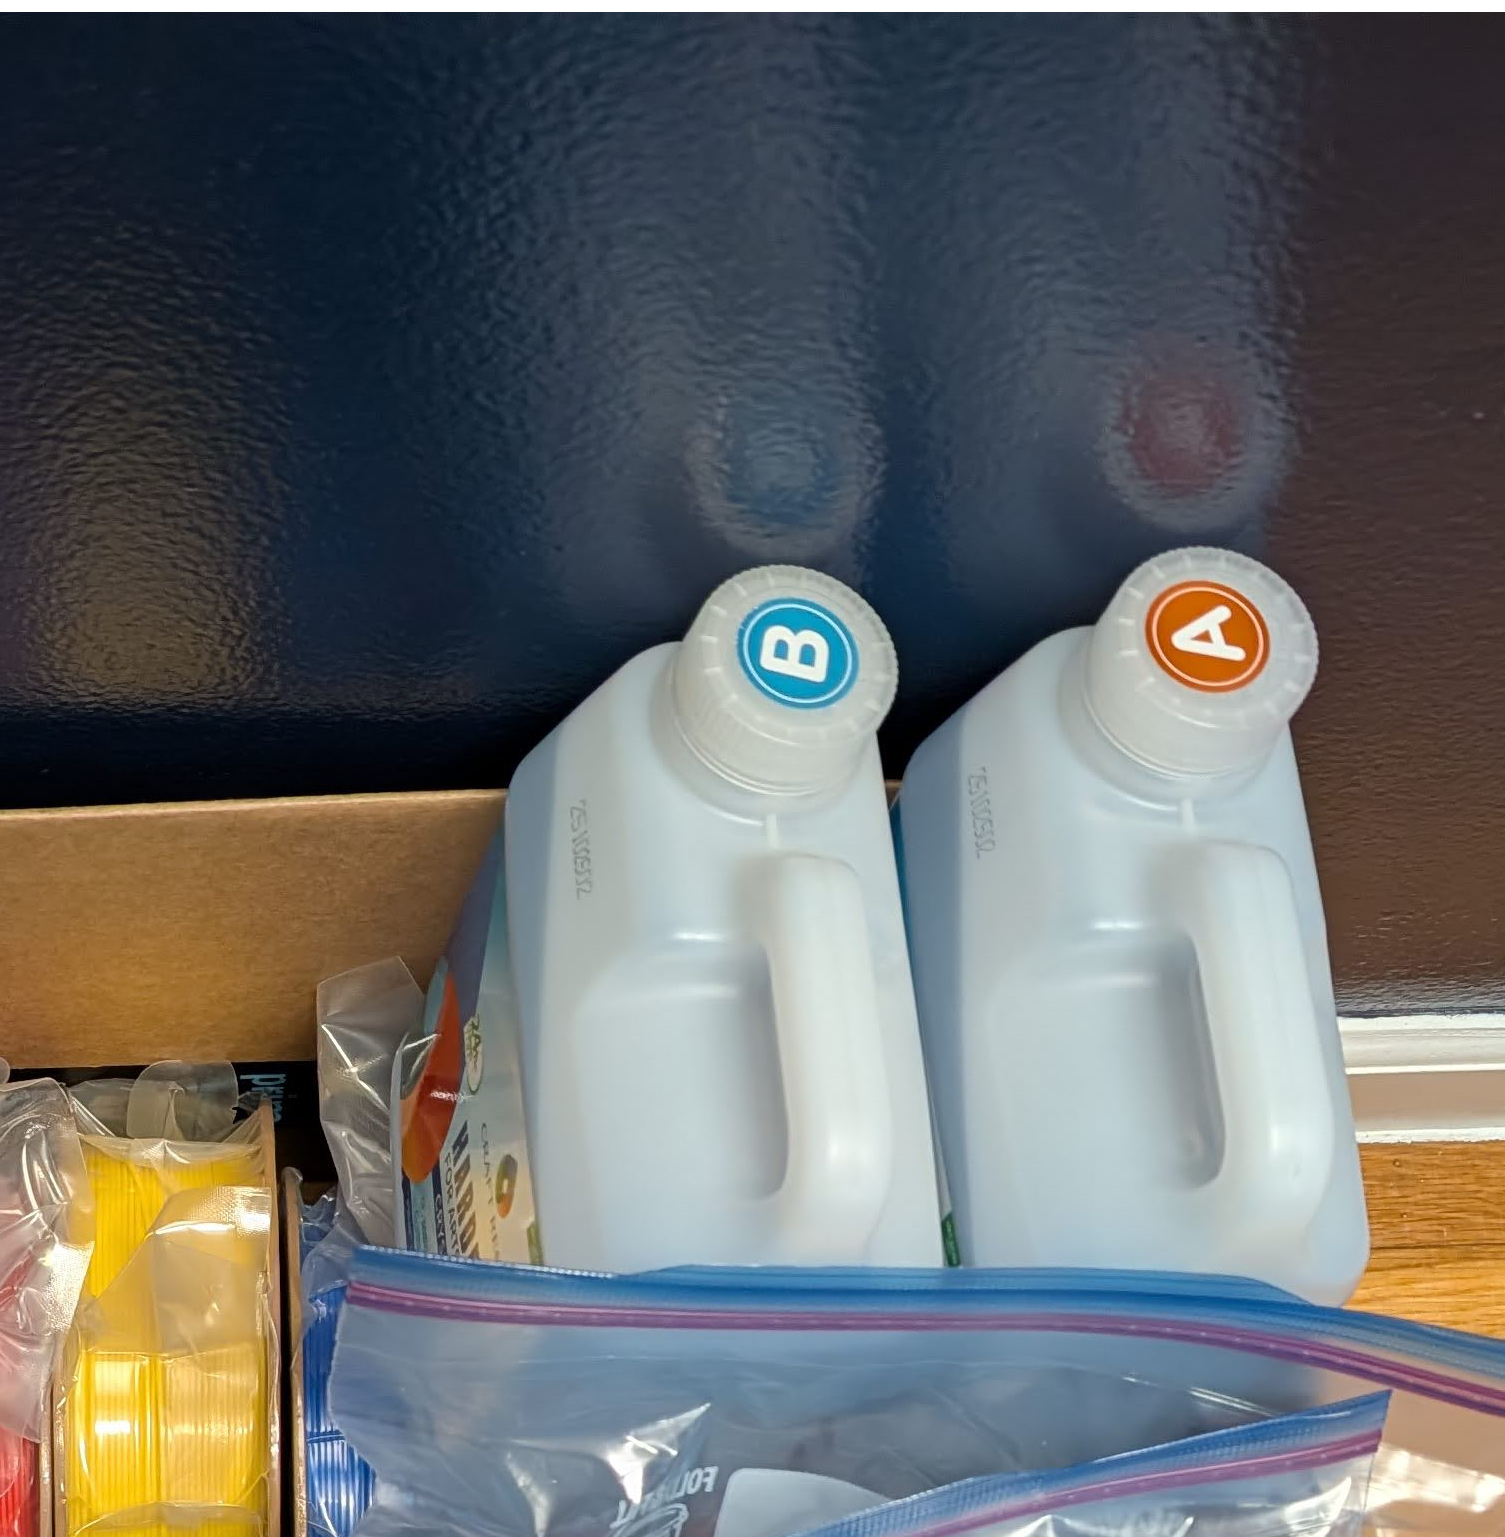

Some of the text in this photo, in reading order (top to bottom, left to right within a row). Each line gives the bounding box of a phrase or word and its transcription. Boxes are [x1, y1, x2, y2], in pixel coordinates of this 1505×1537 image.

[759, 626, 831, 682] B
[1172, 605, 1246, 662] A
[239, 1073, 286, 1122] pri
[444, 1152, 454, 1204] FOR
